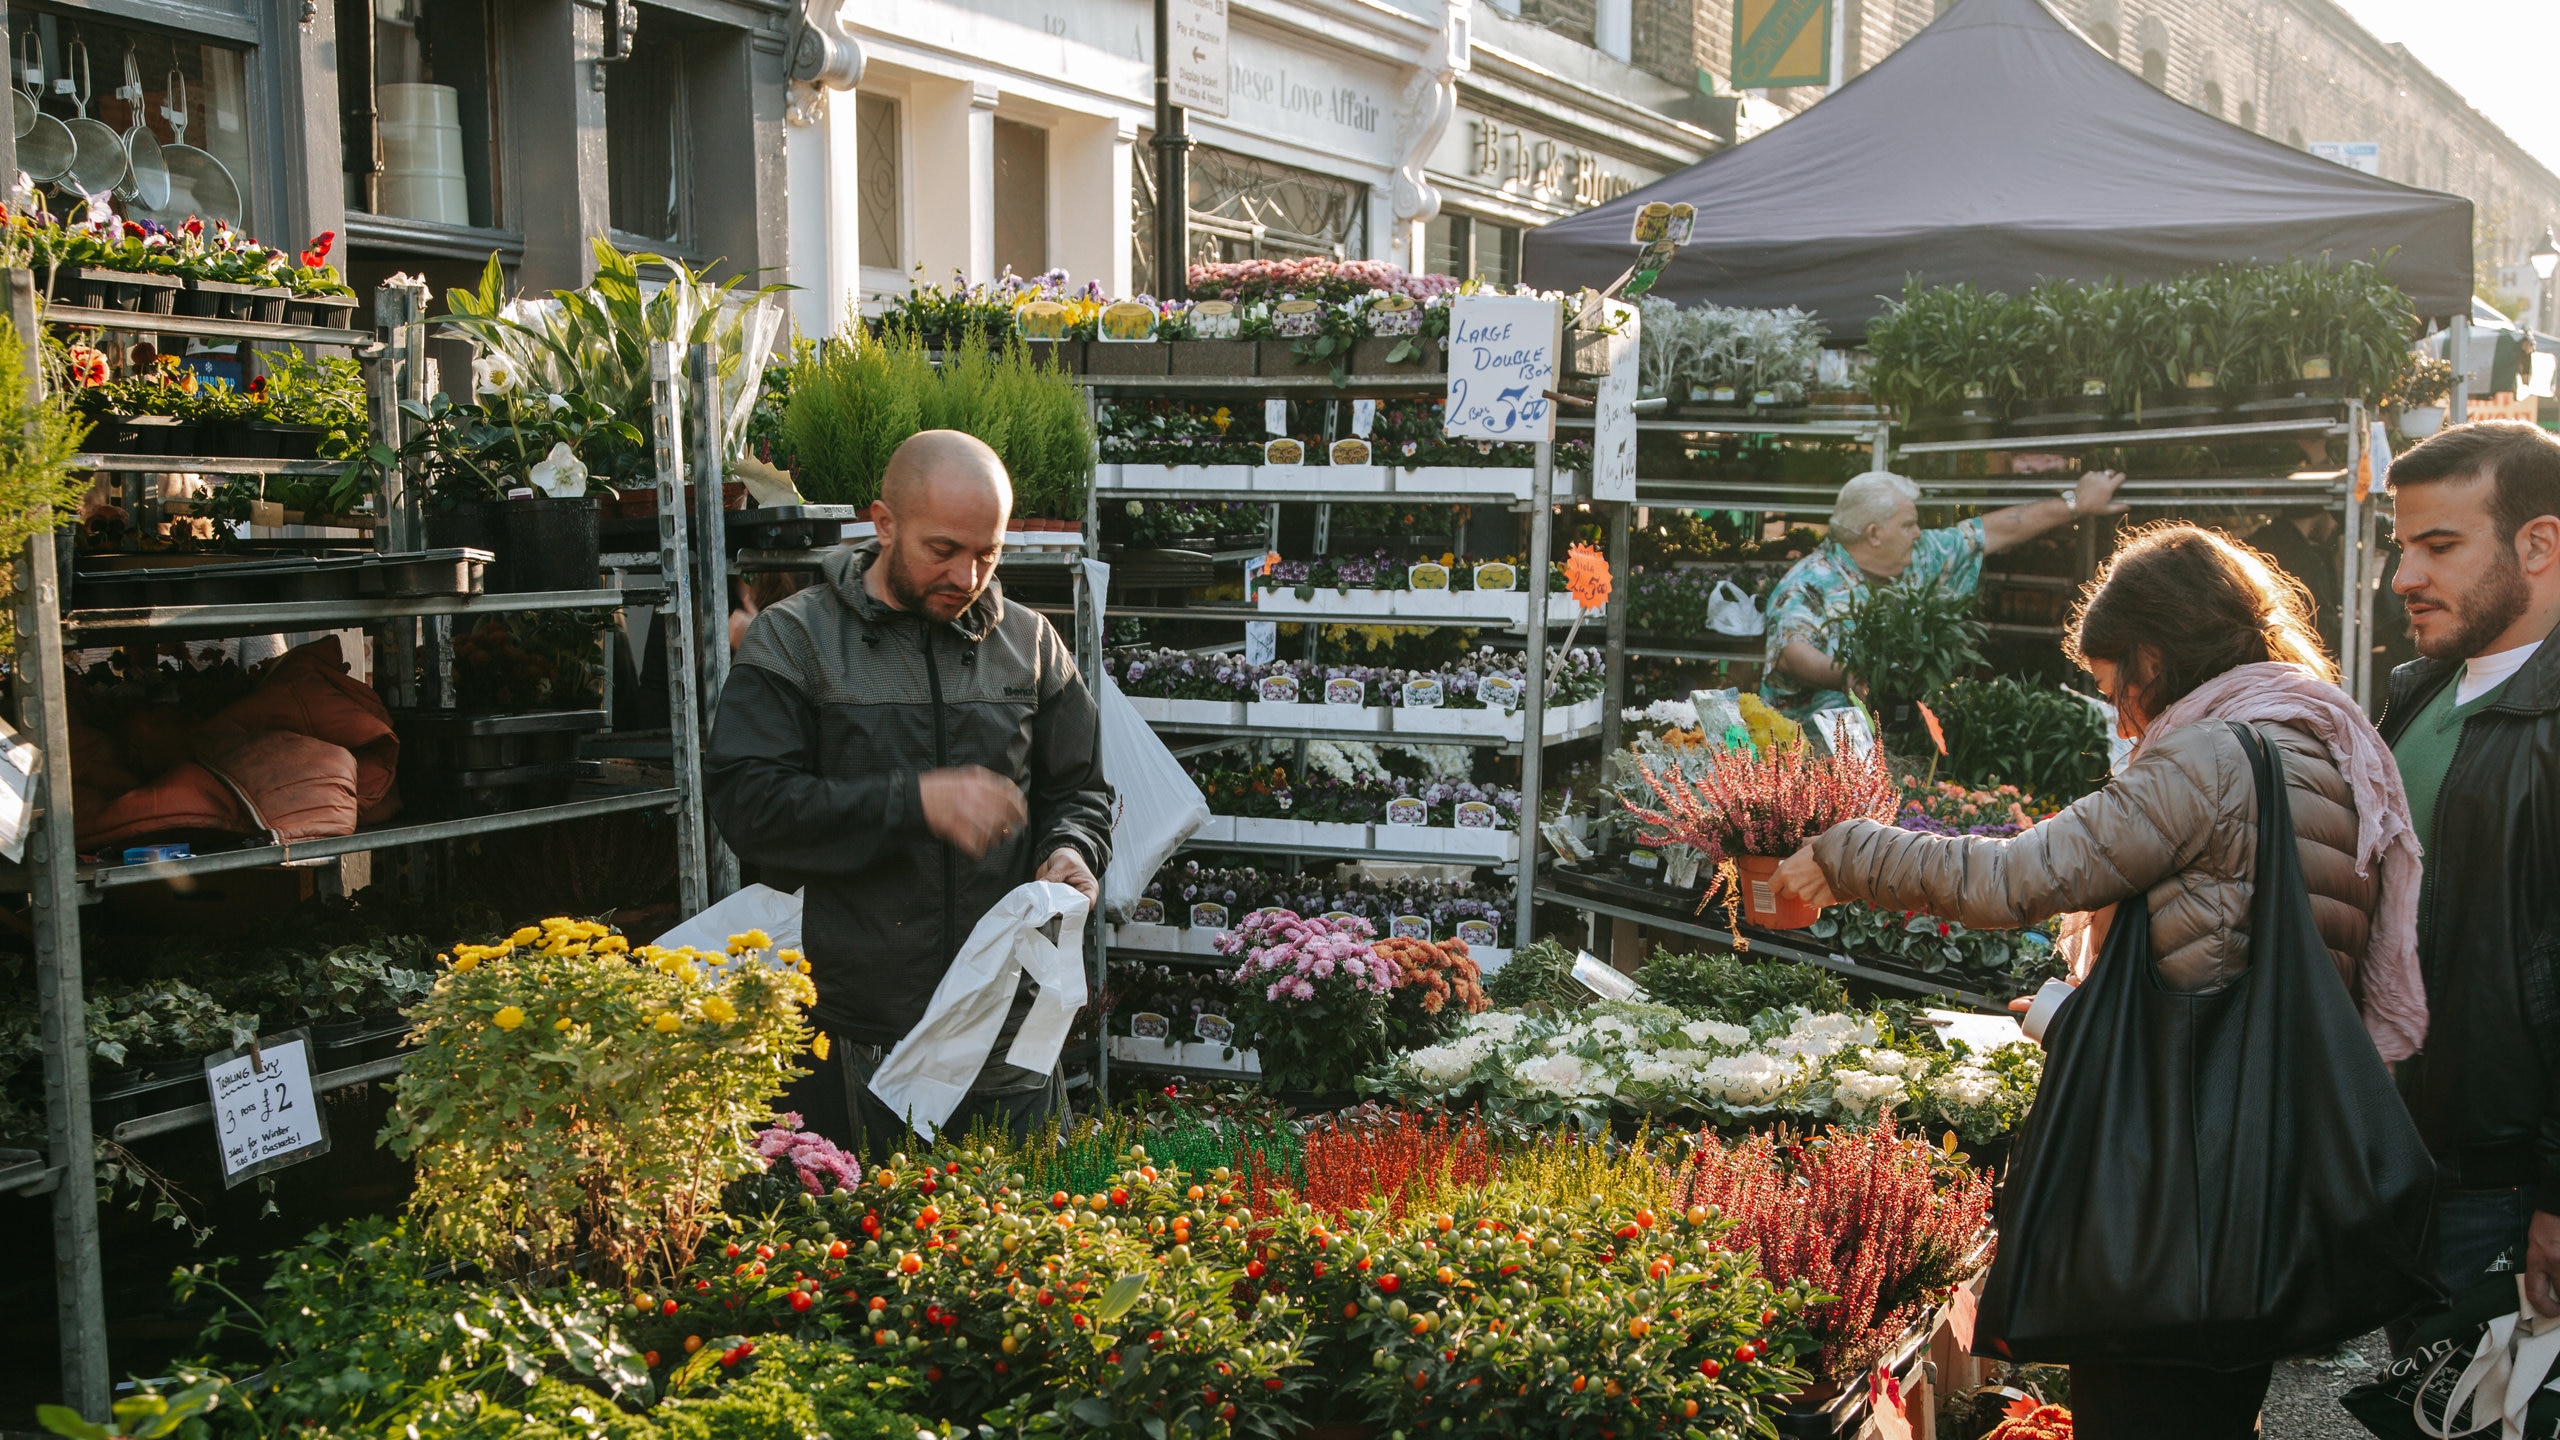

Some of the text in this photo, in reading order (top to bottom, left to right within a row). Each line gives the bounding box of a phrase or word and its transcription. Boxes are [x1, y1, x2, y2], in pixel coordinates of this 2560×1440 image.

[1176, 20, 1221, 45] Pay at machine
[1179, 66, 1219, 89] Display ticket
[1174, 82, 1225, 107] Max stay 4 hours
[1280, 69, 1324, 119] Love
[1327, 85, 1381, 133] Affair
[1456, 319, 1514, 345] LARGE
[1472, 346, 1546, 371] DOUBLE
[1446, 378, 1469, 427] 2
[226, 1109, 237, 1135] 3
[260, 1082, 294, 1123] £2
[247, 1137, 258, 1151] for
[261, 1125, 291, 1142] Winter
[262, 1131, 302, 1155] Baskets!
